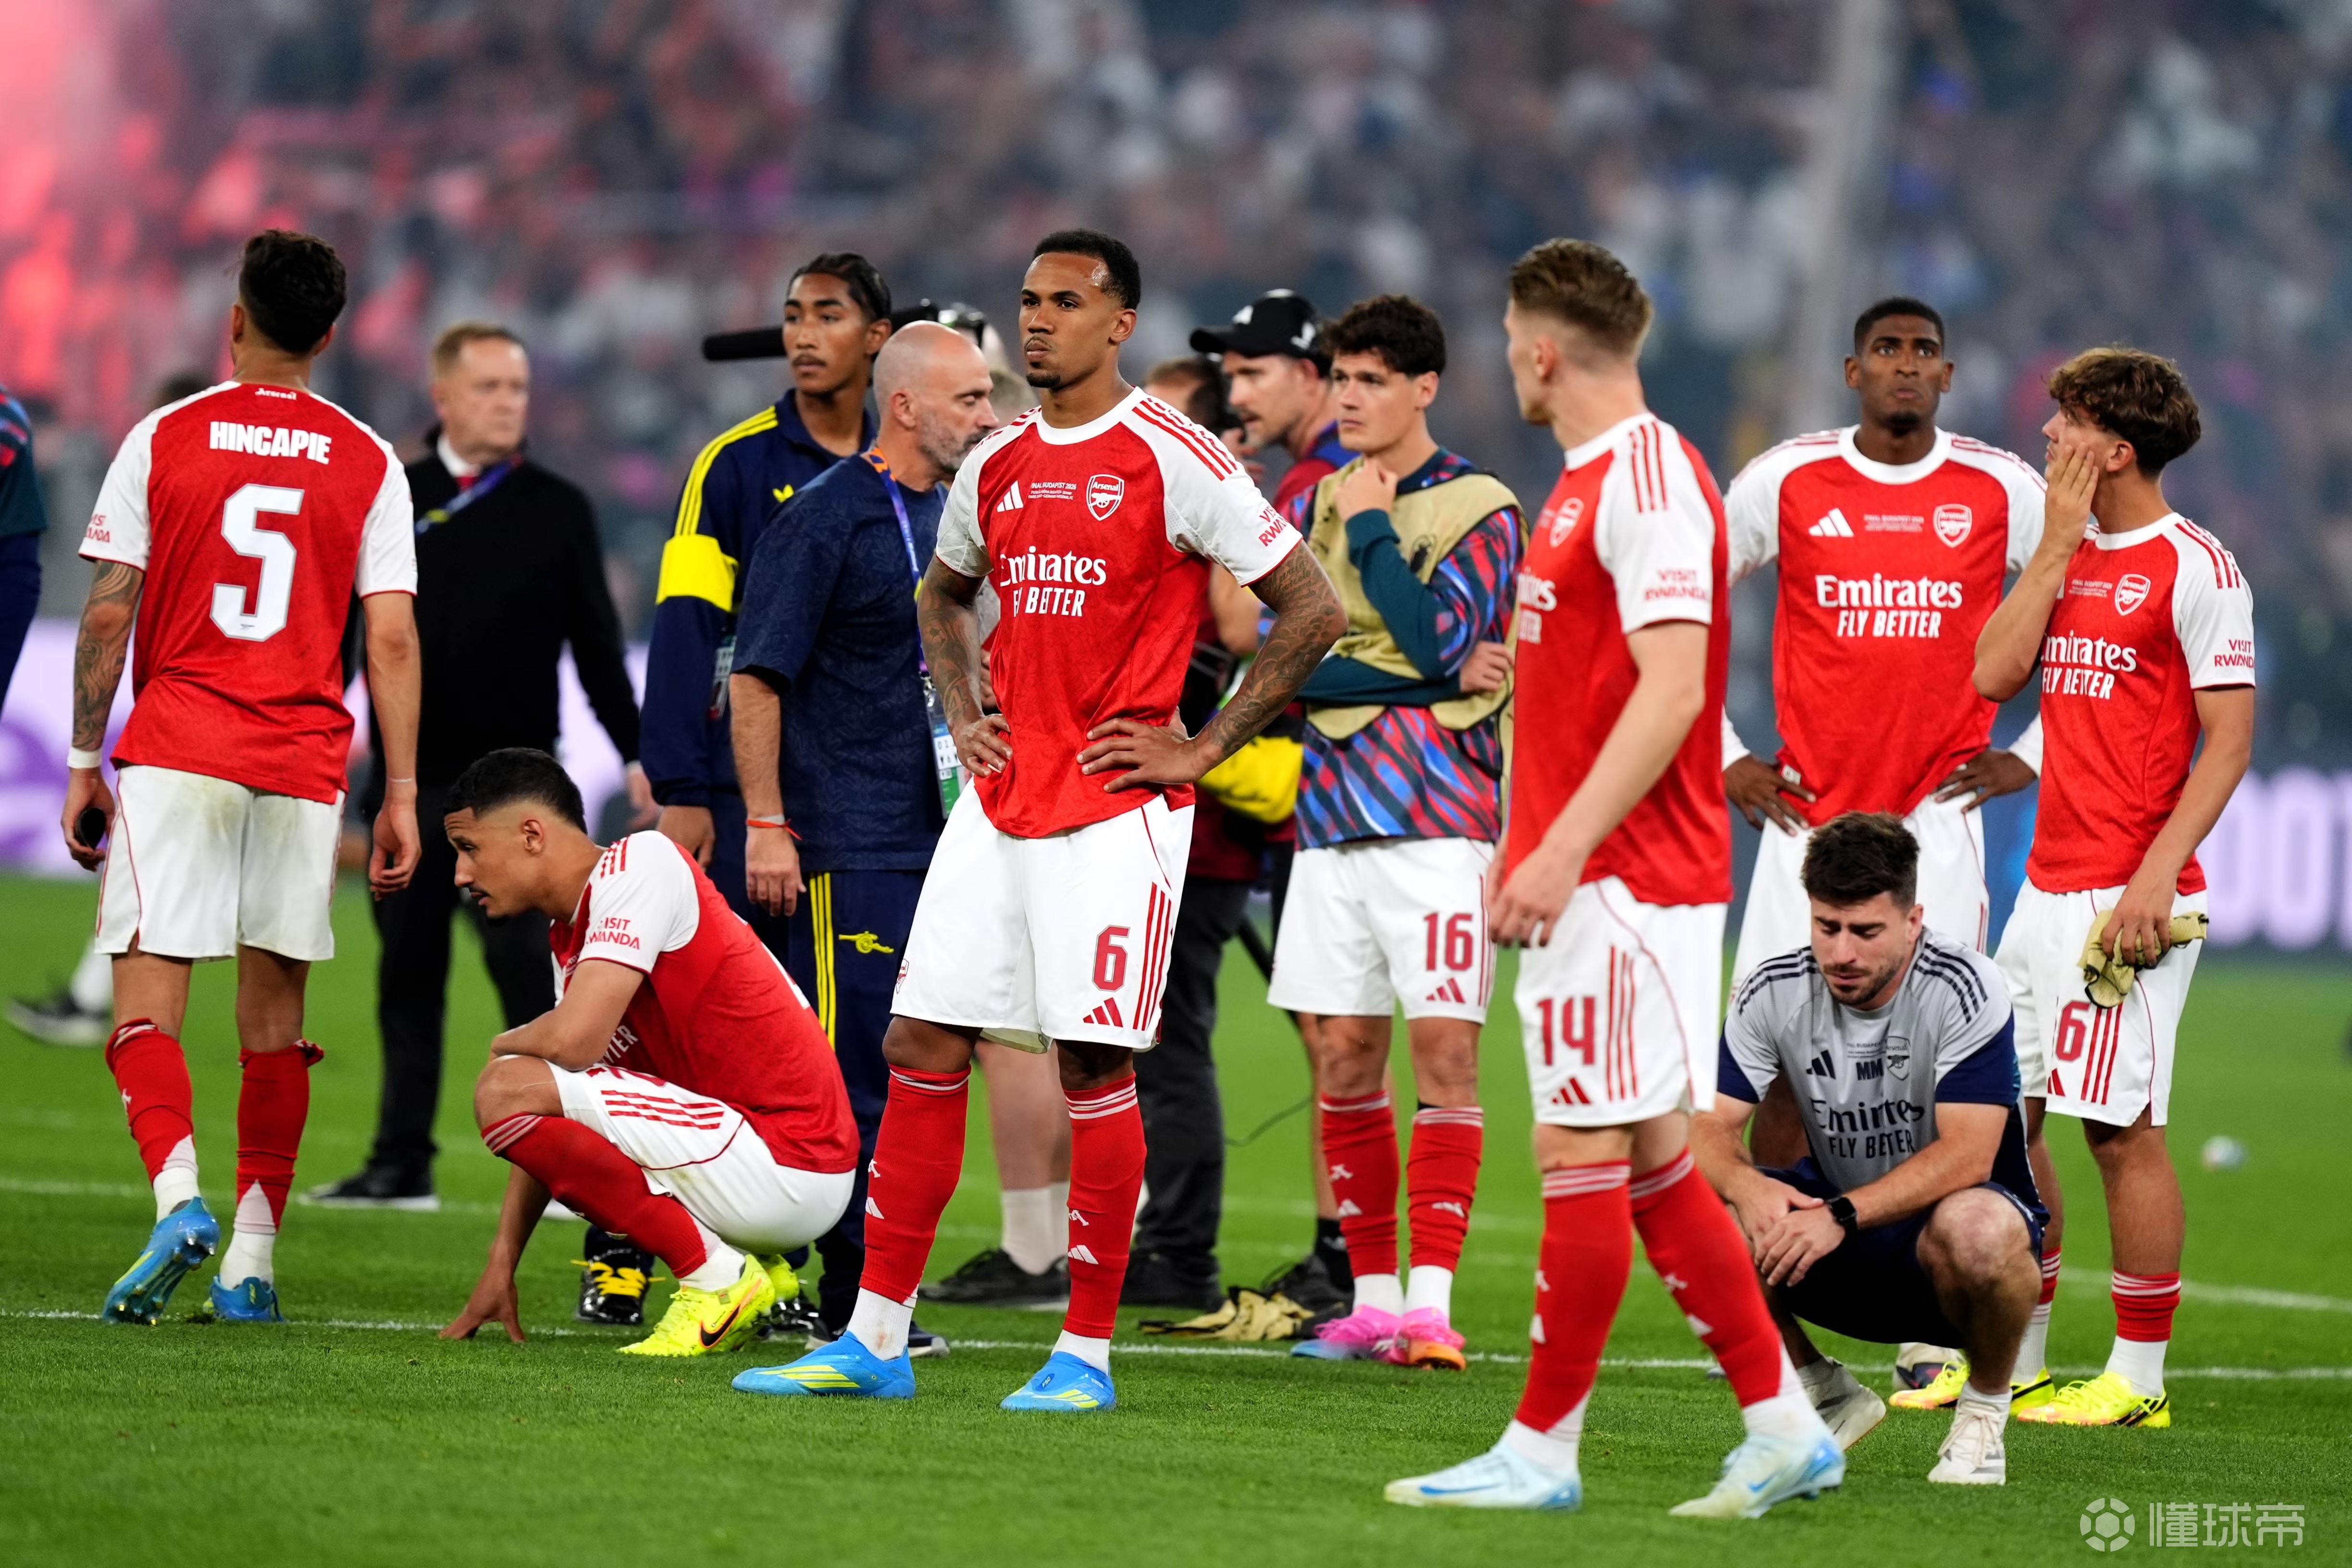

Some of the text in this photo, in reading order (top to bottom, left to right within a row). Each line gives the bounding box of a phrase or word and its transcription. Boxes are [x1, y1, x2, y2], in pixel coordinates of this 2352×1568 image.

[255, 387, 297, 400] Arsenal
[209, 421, 332, 465] HINCAPIE
[1092, 482, 1119, 491] Arsenal
[209, 483, 305, 642] 5
[1815, 572, 1963, 609] Emirates
[1837, 610, 1942, 638] FLY BETTER
[2040, 629, 2137, 672] mirates
[2229, 639, 2252, 654] VISIT
[2042, 667, 2115, 700] FLY BETTER
[597, 917, 631, 930] ISIT
[586, 931, 640, 950] WANDA
[1423, 912, 1474, 971] 16
[1092, 925, 1131, 992] 6
[1537, 996, 1595, 1066] 14
[1856, 1057, 1884, 1081] MM
[1810, 1096, 1925, 1133] Emirtes
[1829, 1137, 1857, 1159] FLY
